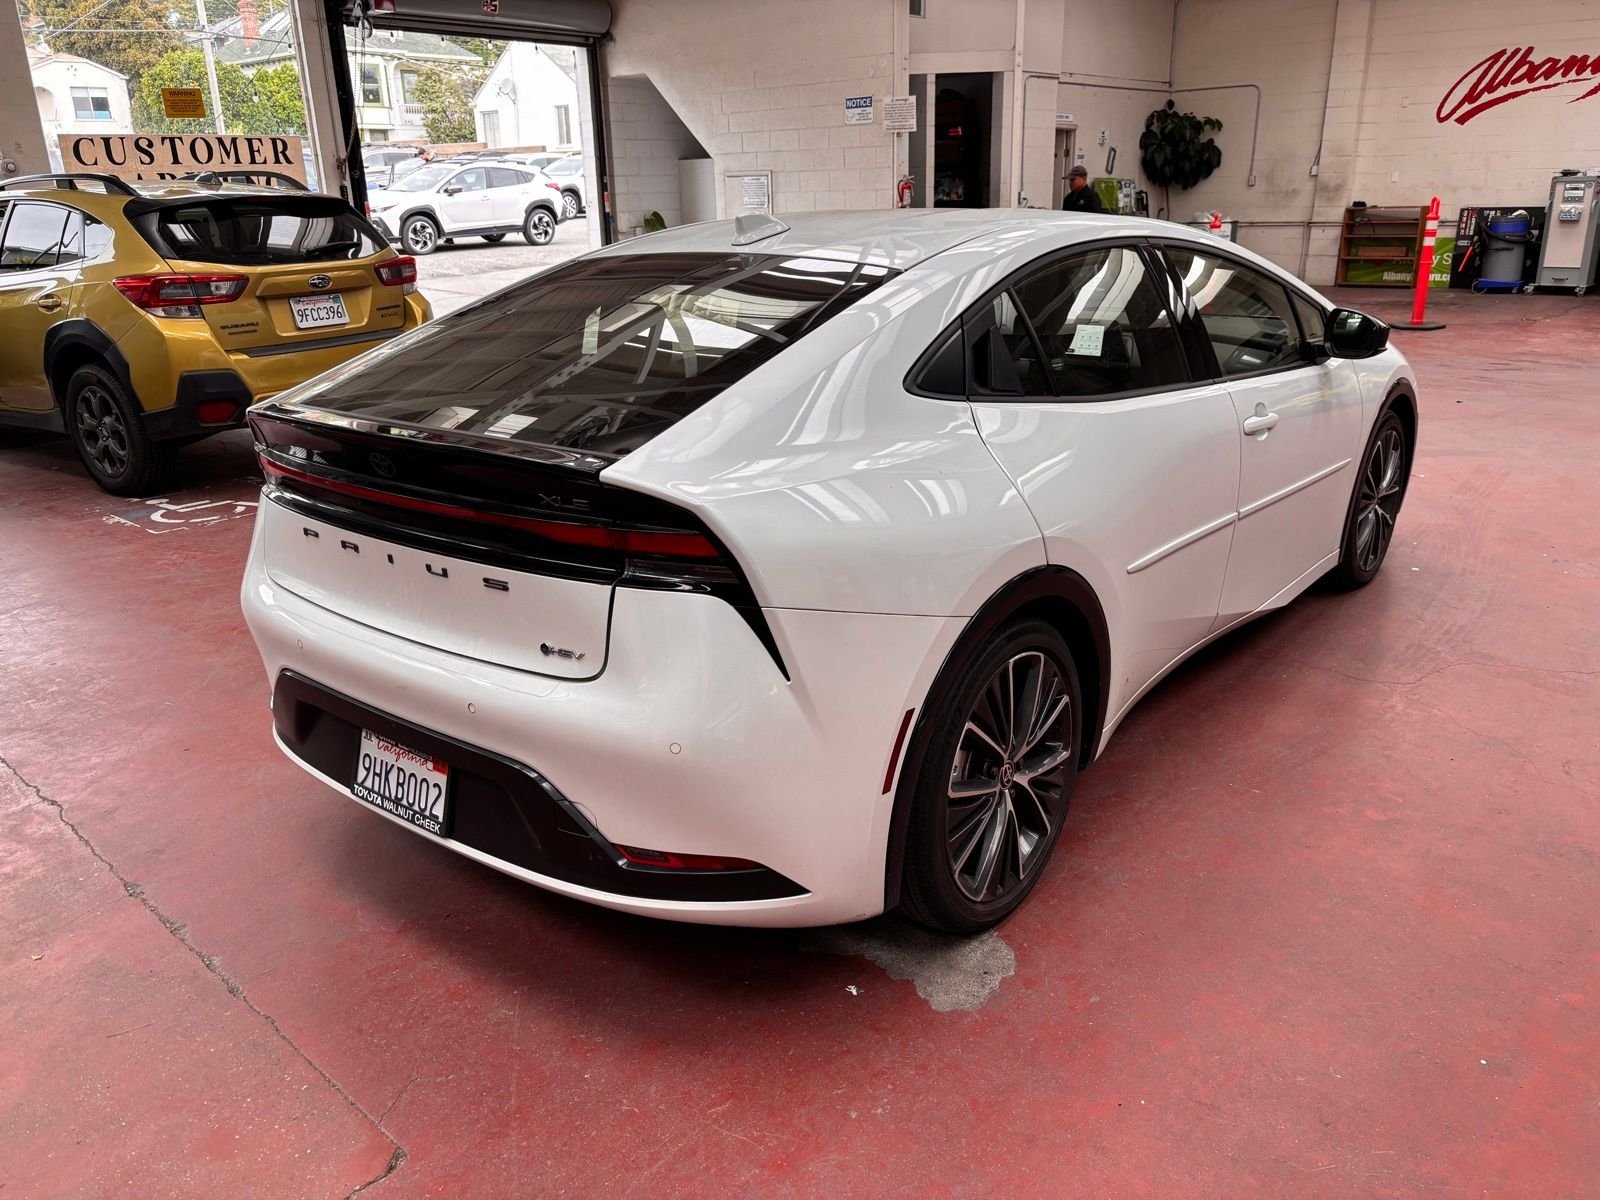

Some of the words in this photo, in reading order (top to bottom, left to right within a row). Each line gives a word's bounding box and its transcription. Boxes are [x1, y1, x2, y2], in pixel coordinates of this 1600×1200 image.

[1436, 46, 1600, 123] Alban
[846, 97, 872, 108] NOTICE
[72, 136, 294, 166] CUSTOMER
[297, 305, 343, 323] 9FCC396
[538, 493, 591, 510] XLE
[303, 527, 509, 592] PRIUS
[354, 784, 382, 807] TOYOTA
[383, 799, 413, 821] WALNUT
[361, 752, 442, 821] 9HKB002
